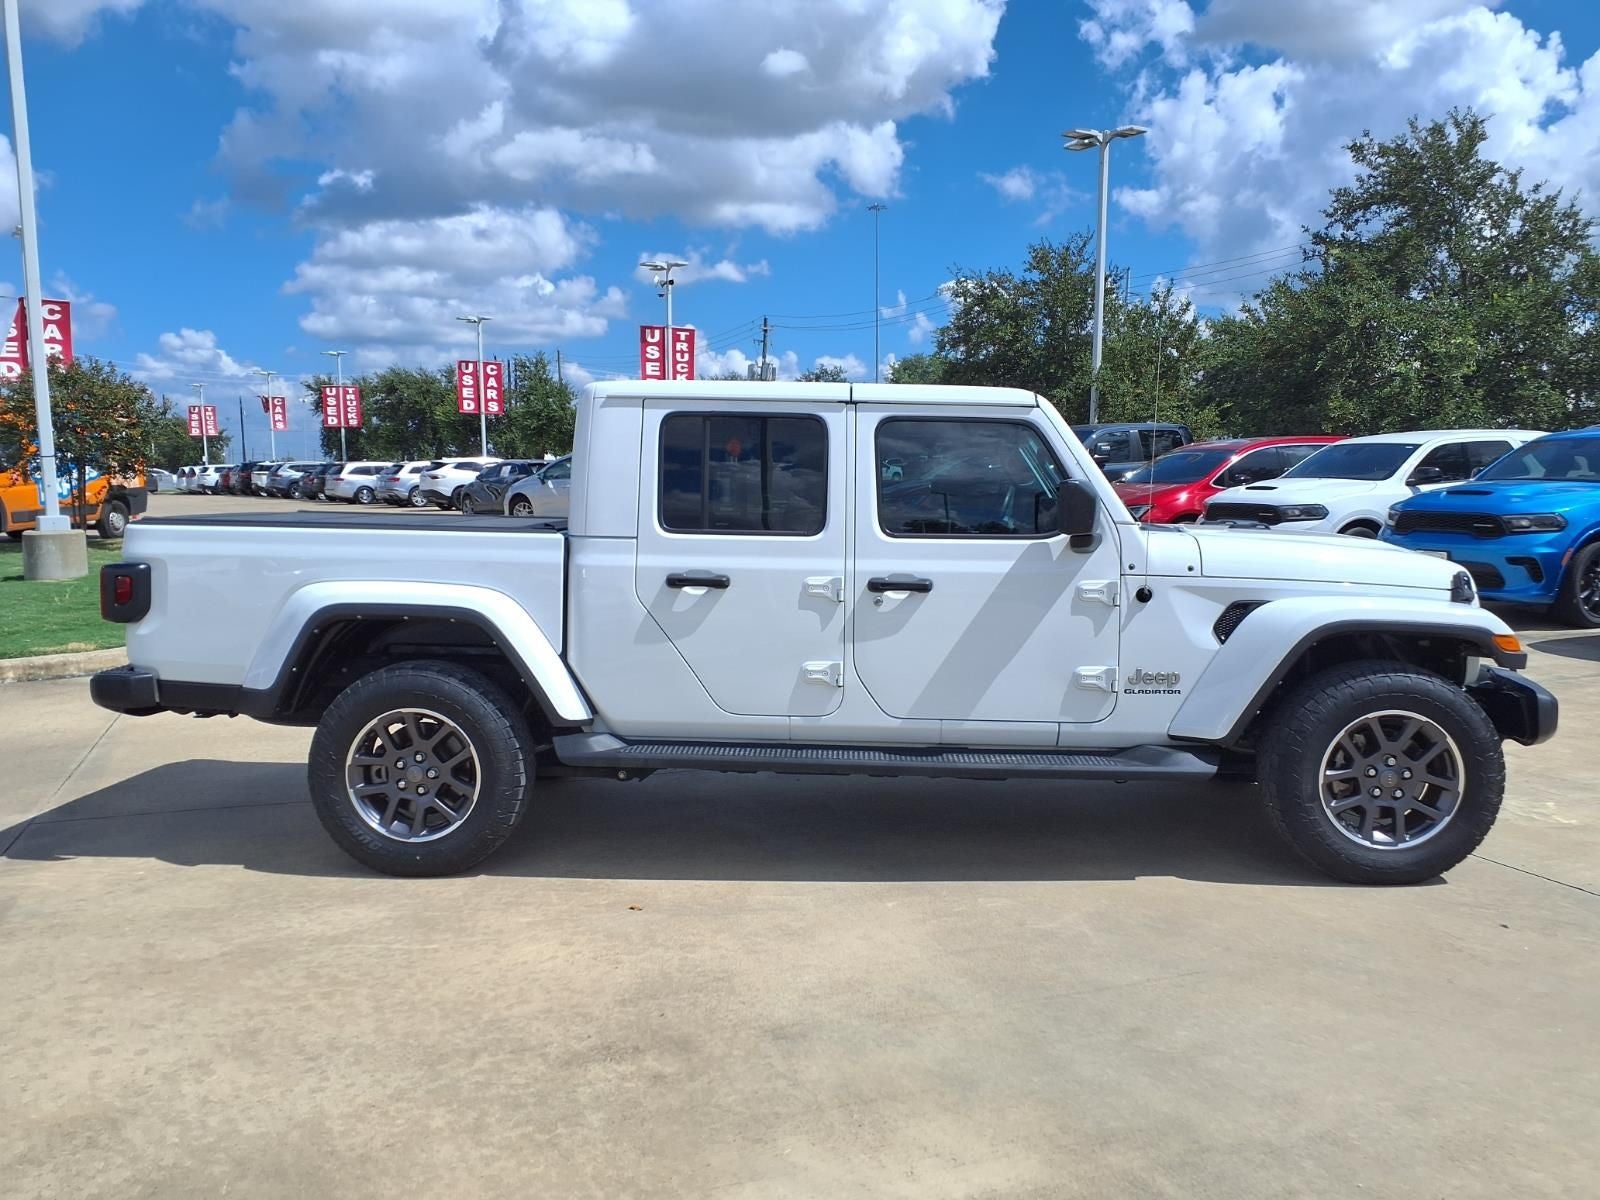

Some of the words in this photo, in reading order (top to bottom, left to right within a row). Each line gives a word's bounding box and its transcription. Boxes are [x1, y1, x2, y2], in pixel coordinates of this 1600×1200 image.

[41, 304, 66, 374] CAR
[645, 328, 660, 380] USE
[461, 362, 475, 411] USED
[486, 364, 499, 412] CARS
[190, 406, 200, 434] USED
[274, 397, 285, 429] CARS
[325, 387, 338, 425] USED
[345, 387, 358, 425] TRUCKS
[1127, 667, 1181, 688] Jeep
